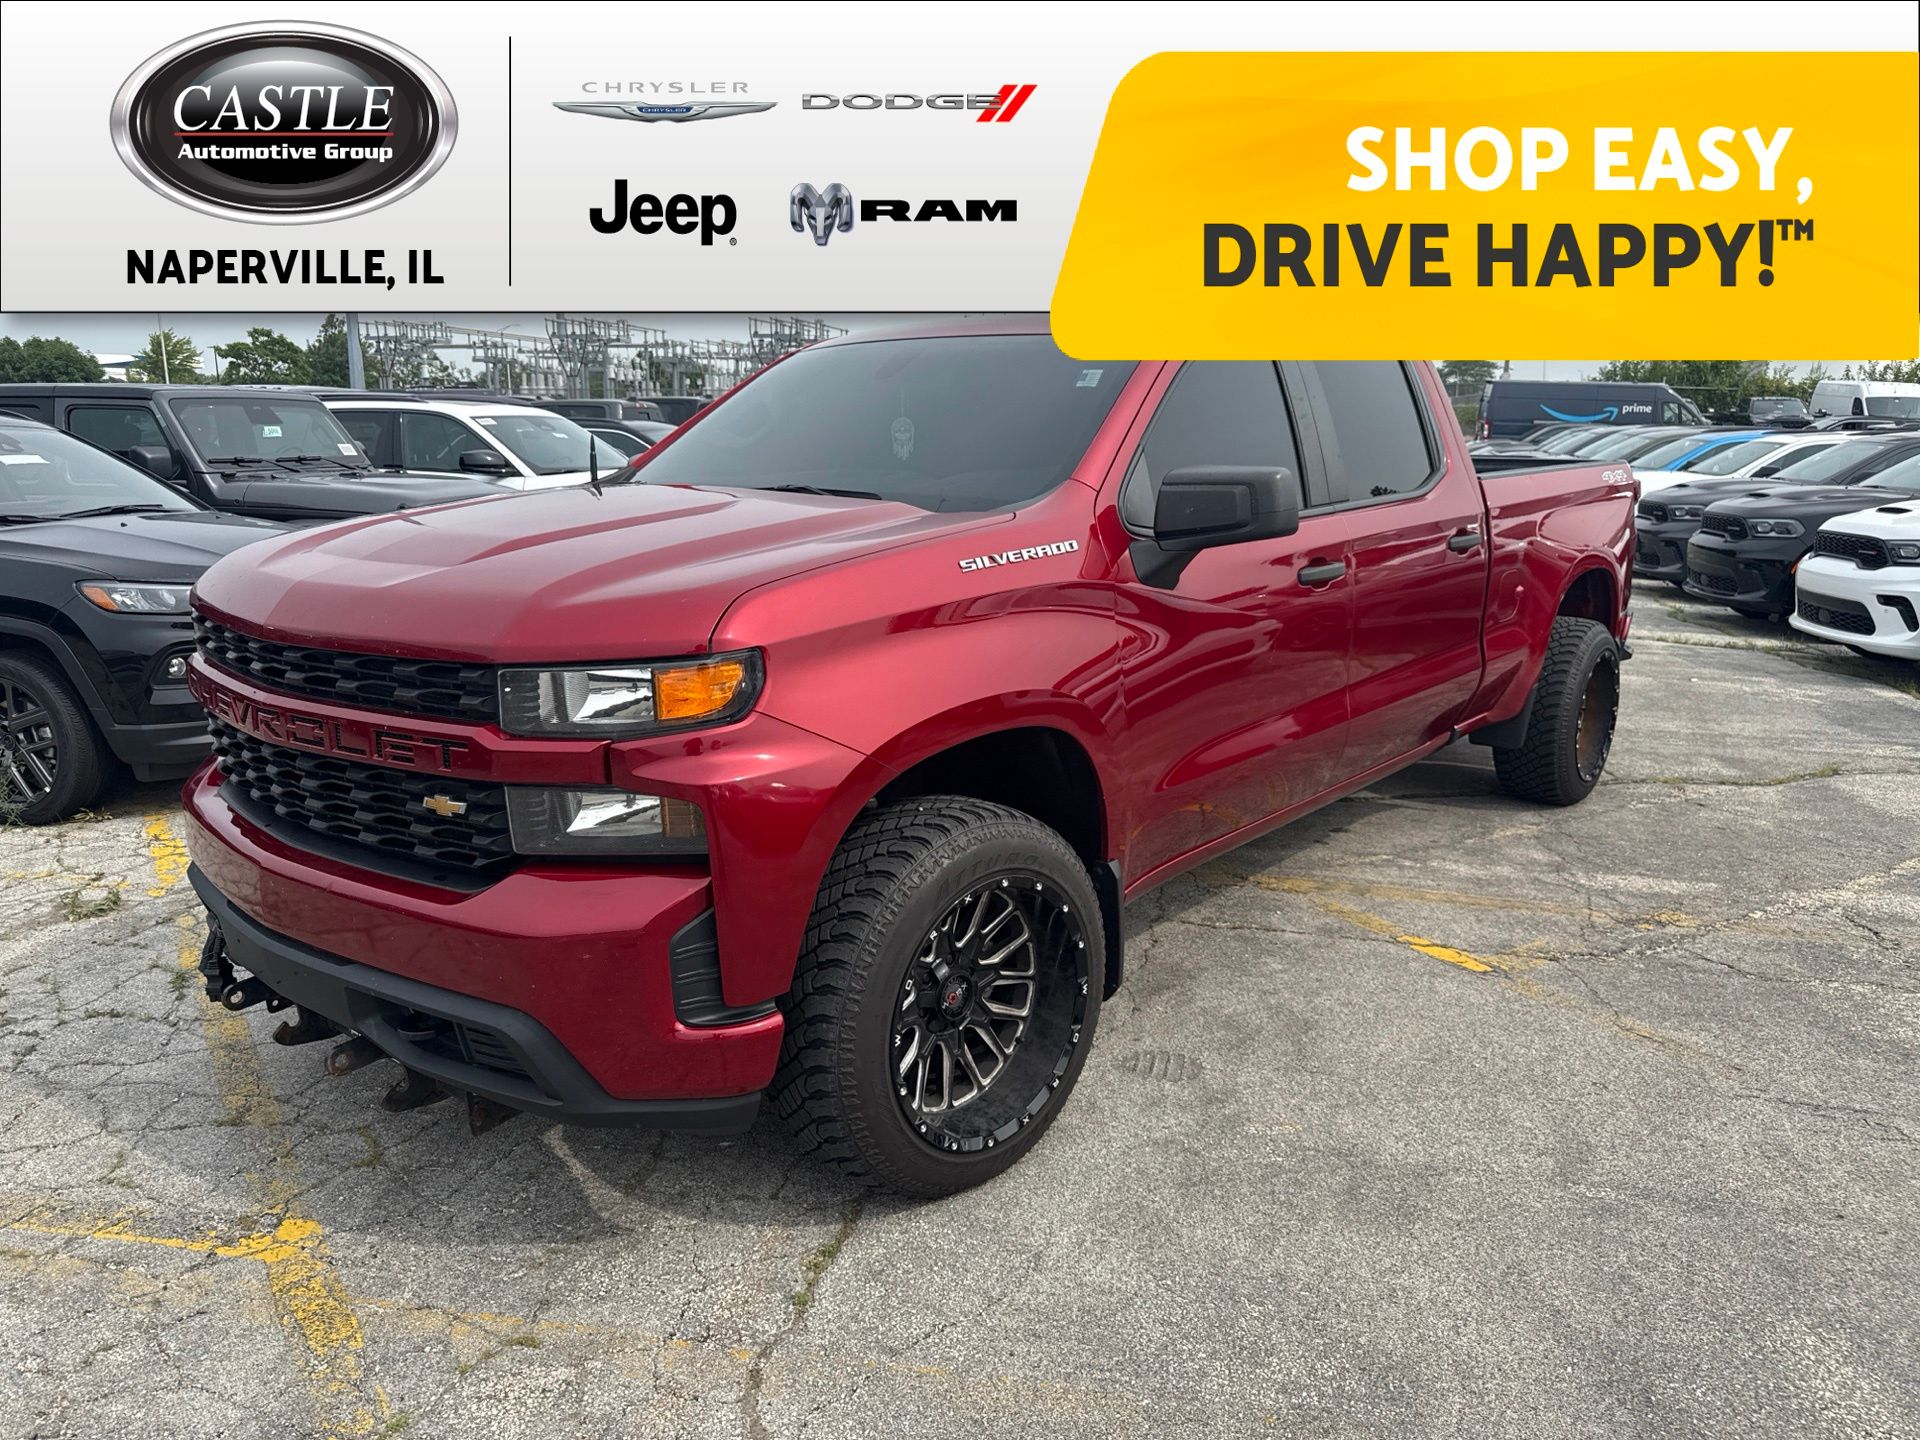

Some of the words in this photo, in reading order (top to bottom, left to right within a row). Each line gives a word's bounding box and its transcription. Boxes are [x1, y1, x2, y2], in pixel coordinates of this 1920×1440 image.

[1622, 403, 1652, 414] prime
[959, 539, 1079, 573] SILVERADO
[188, 671, 470, 772] CHEVROLET
